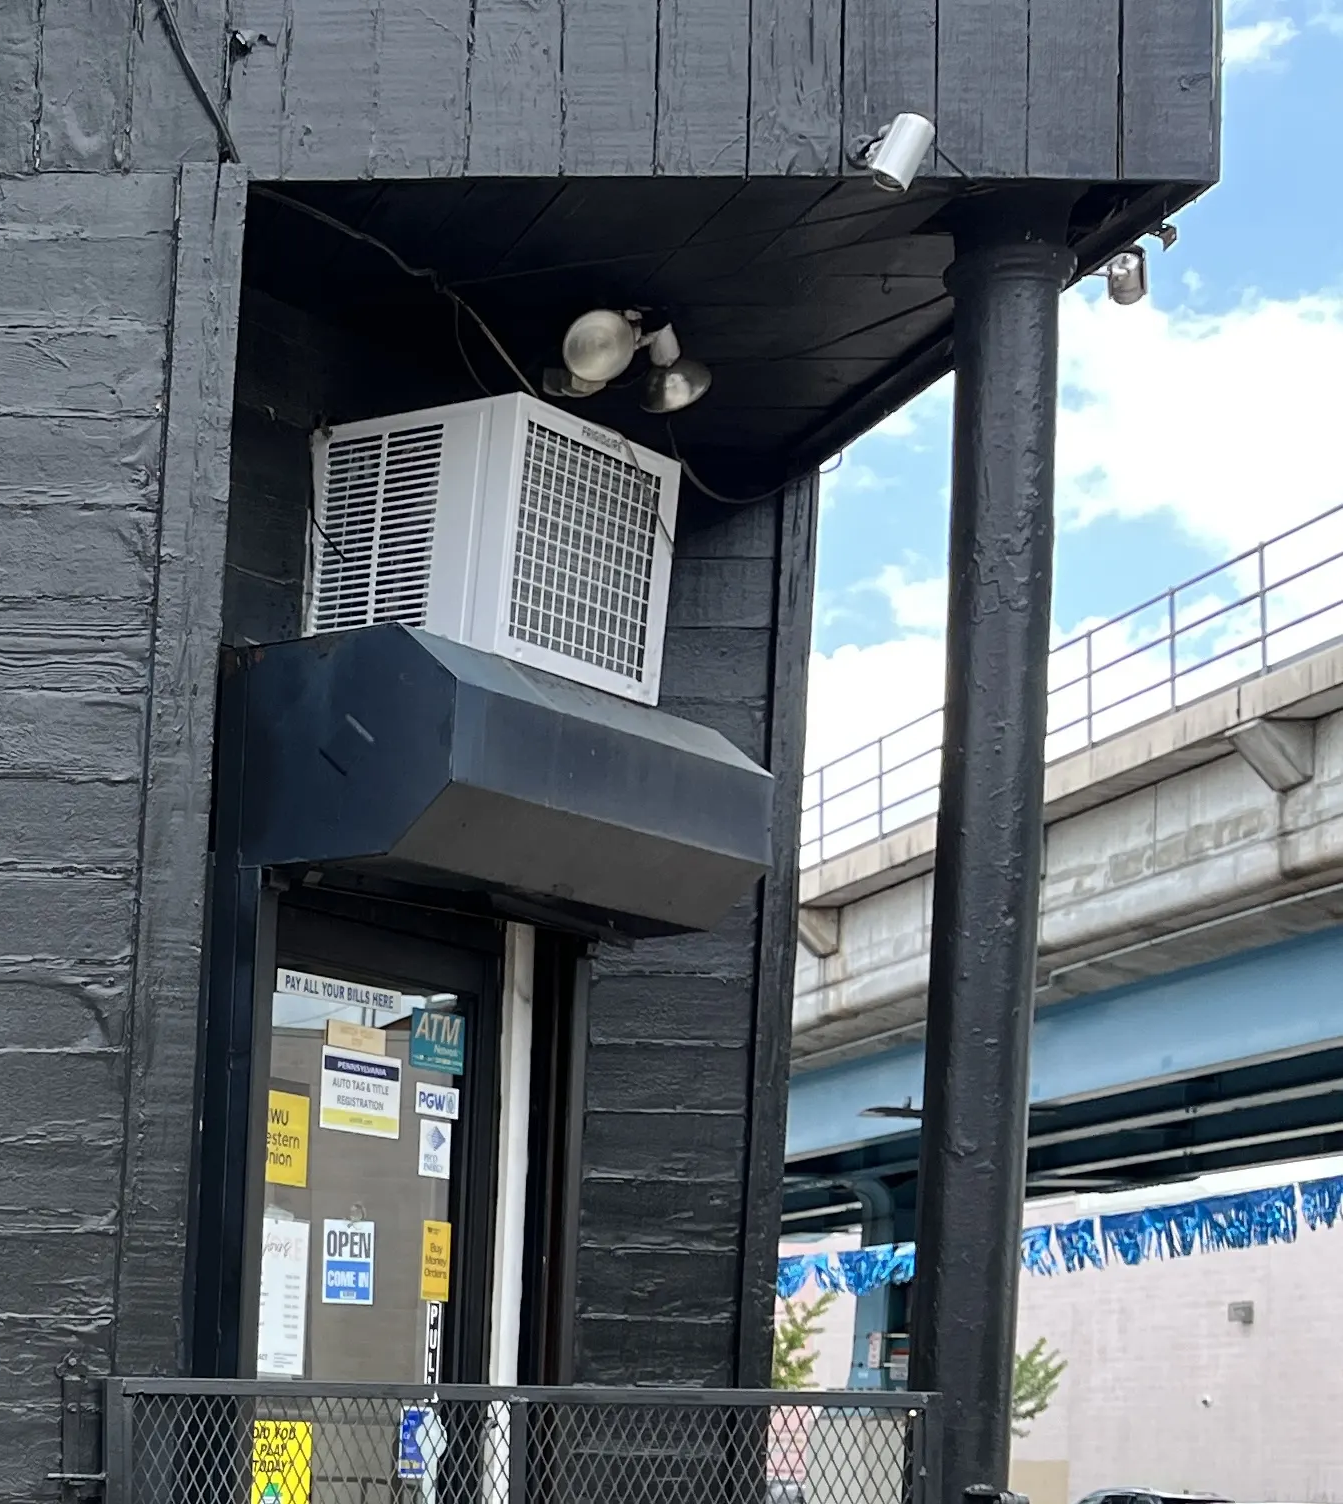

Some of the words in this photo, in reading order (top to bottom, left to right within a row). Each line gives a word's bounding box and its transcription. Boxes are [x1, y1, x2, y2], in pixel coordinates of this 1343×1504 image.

[285, 975, 301, 990] PAY
[304, 978, 319, 994] ALL
[322, 981, 344, 999] YOUR
[348, 987, 370, 1004] BILLS
[372, 992, 393, 1009] HERE
[415, 1012, 461, 1046] ATM
[337, 1061, 387, 1077] PENNSYLVANIA
[332, 1077, 350, 1090] AUTO
[352, 1080, 366, 1092] TAG
[373, 1083, 389, 1096] TITLE
[337, 1094, 384, 1111] REGISTRATION
[419, 1091, 445, 1111] PGW
[266, 1131, 300, 1149] estern
[266, 1147, 292, 1167] nion
[327, 1230, 371, 1258] OPEN
[430, 1243, 443, 1256] Buy
[425, 1254, 447, 1268] Money
[327, 1270, 356, 1288] COME
[358, 1272, 369, 1288] IN
[424, 1268, 447, 1279] Orders
